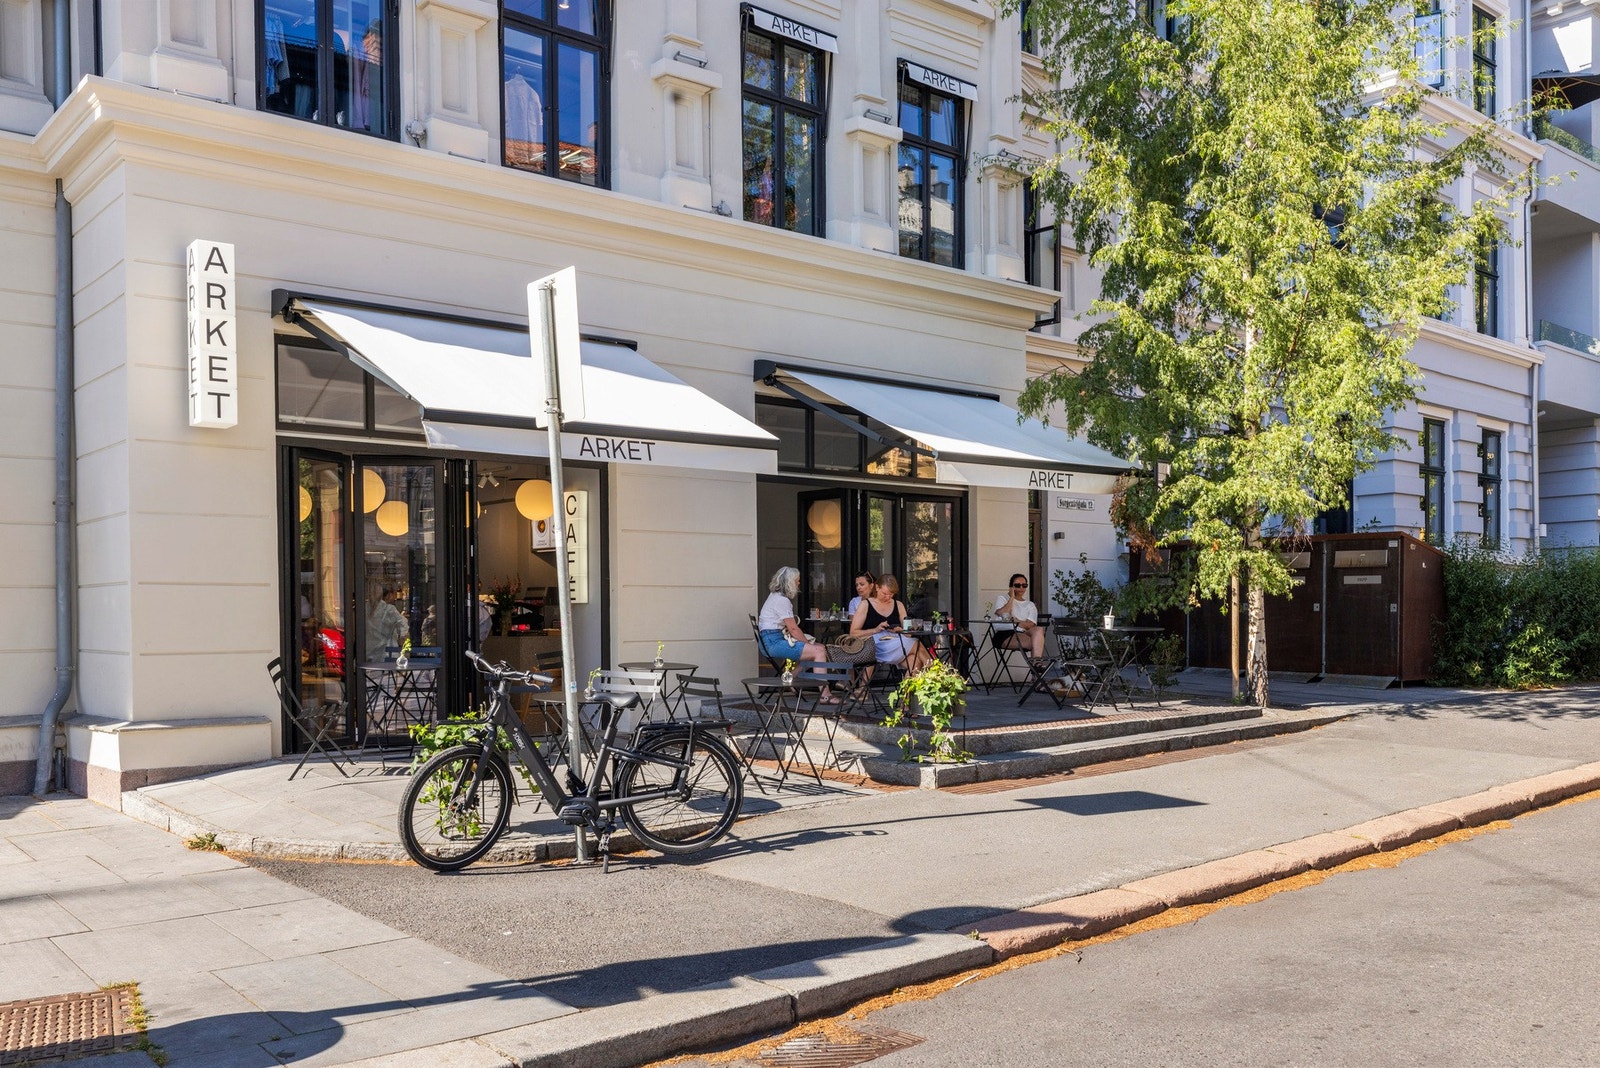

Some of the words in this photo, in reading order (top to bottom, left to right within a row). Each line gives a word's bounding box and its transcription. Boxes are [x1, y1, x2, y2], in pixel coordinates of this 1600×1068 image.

[772, 16, 820, 45] ARKET
[922, 69, 964, 94] ARKET
[188, 248, 198, 419] ARKET
[204, 246, 230, 419] ARKET
[579, 436, 656, 461] ARKET
[1029, 470, 1073, 489] ARKET
